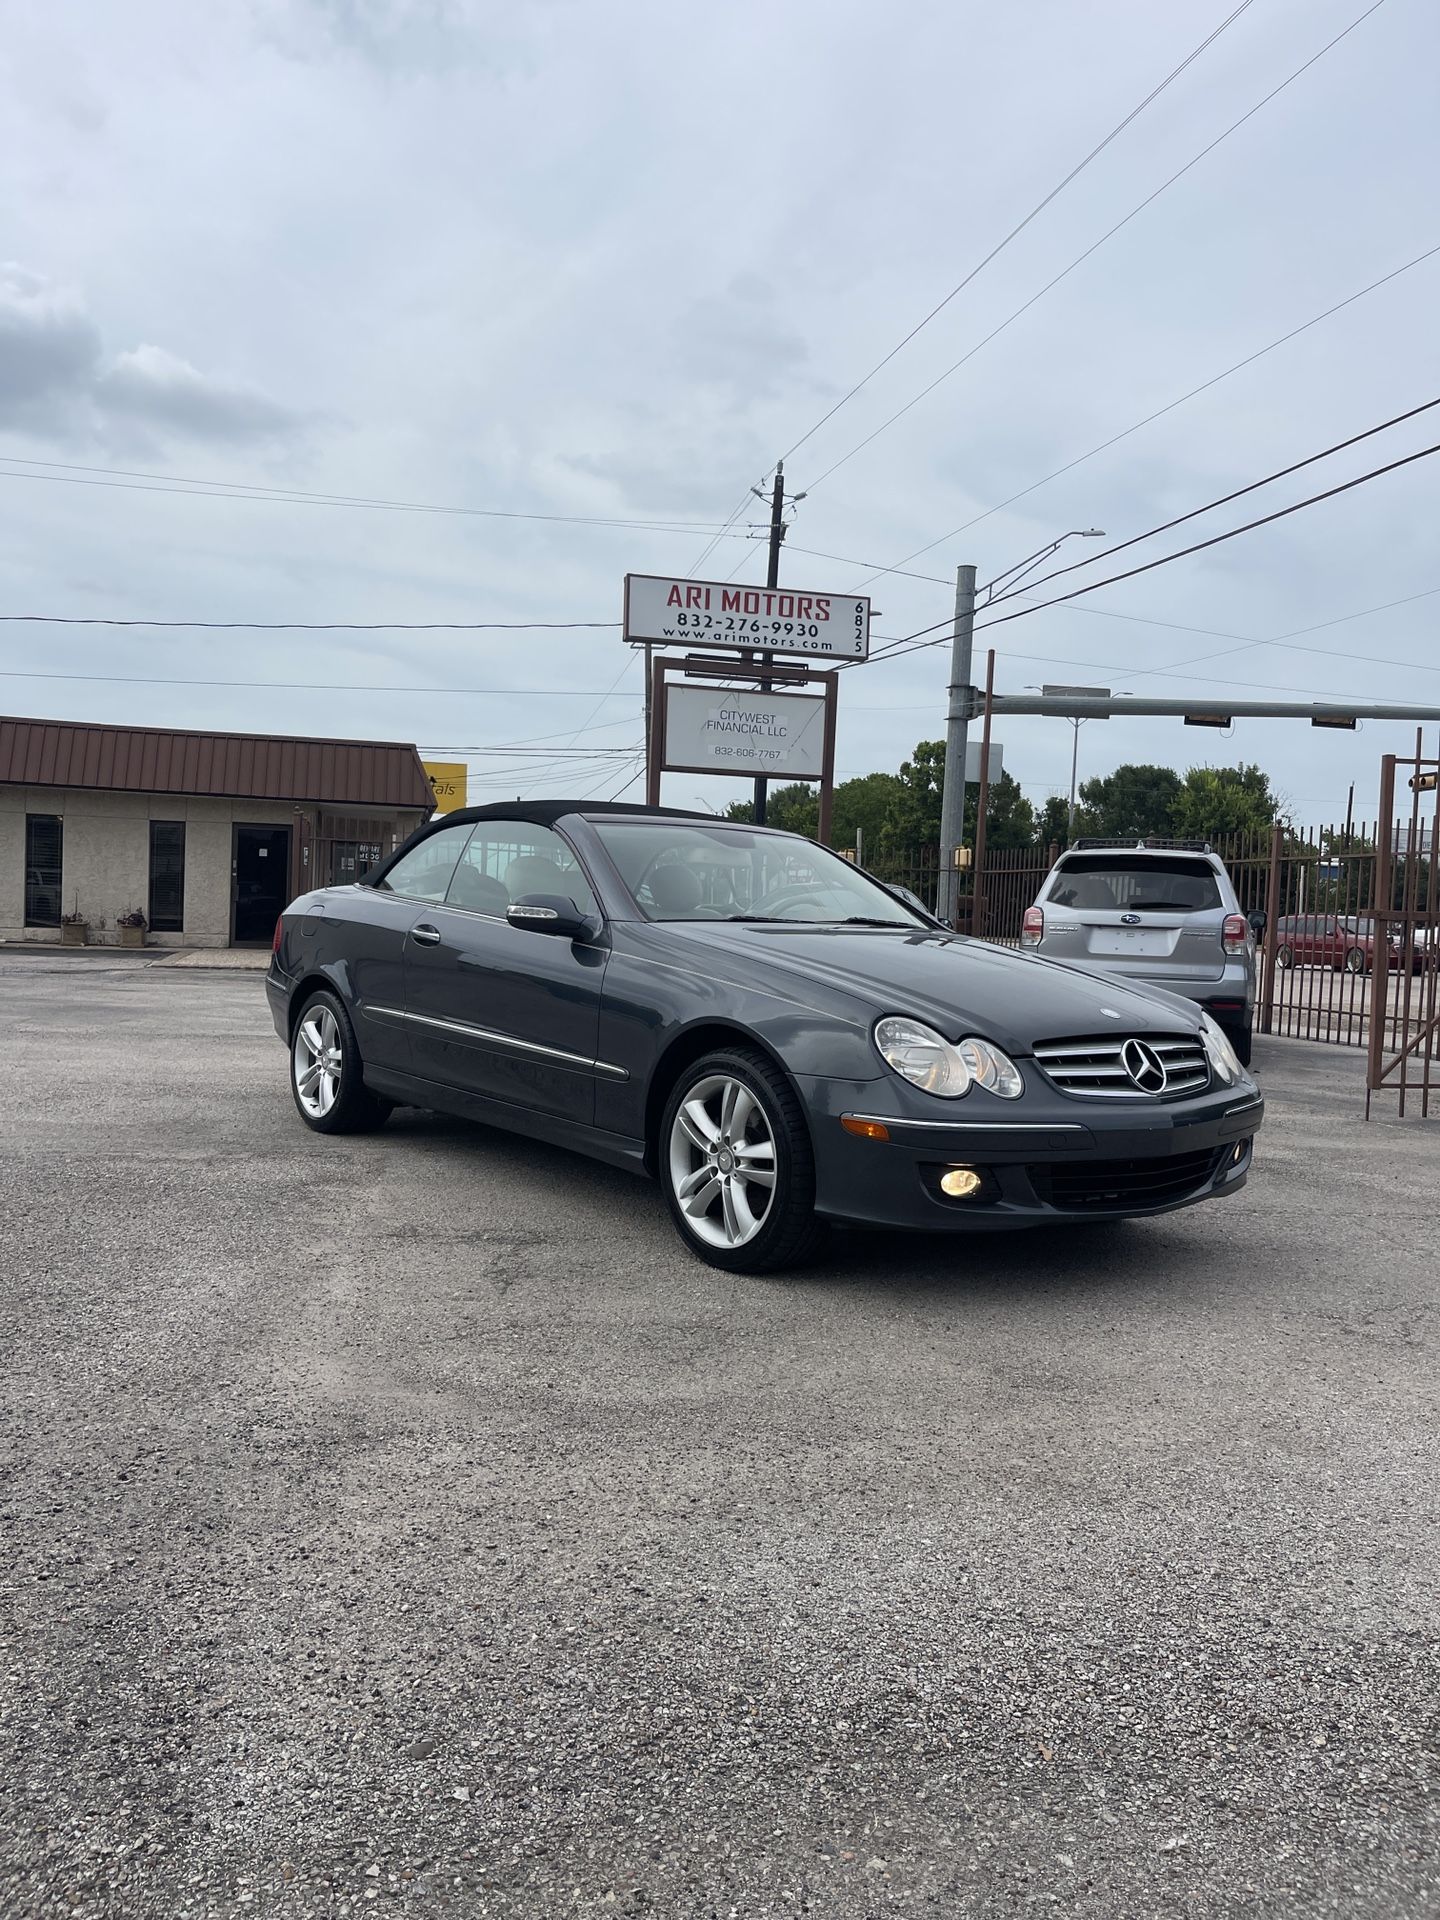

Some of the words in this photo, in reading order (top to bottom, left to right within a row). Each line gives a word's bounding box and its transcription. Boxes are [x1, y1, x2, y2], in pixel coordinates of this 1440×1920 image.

[667, 585, 711, 610] ARI
[721, 589, 831, 621] MOTORS
[677, 612, 819, 638] 832-276-9930
[663, 628, 833, 651] www.arimotors.com
[720, 709, 776, 724] CITYWEST
[706, 720, 765, 735] FINANCIAL
[767, 726, 787, 737] LLC
[714, 746, 781, 759] 832-606-7767
